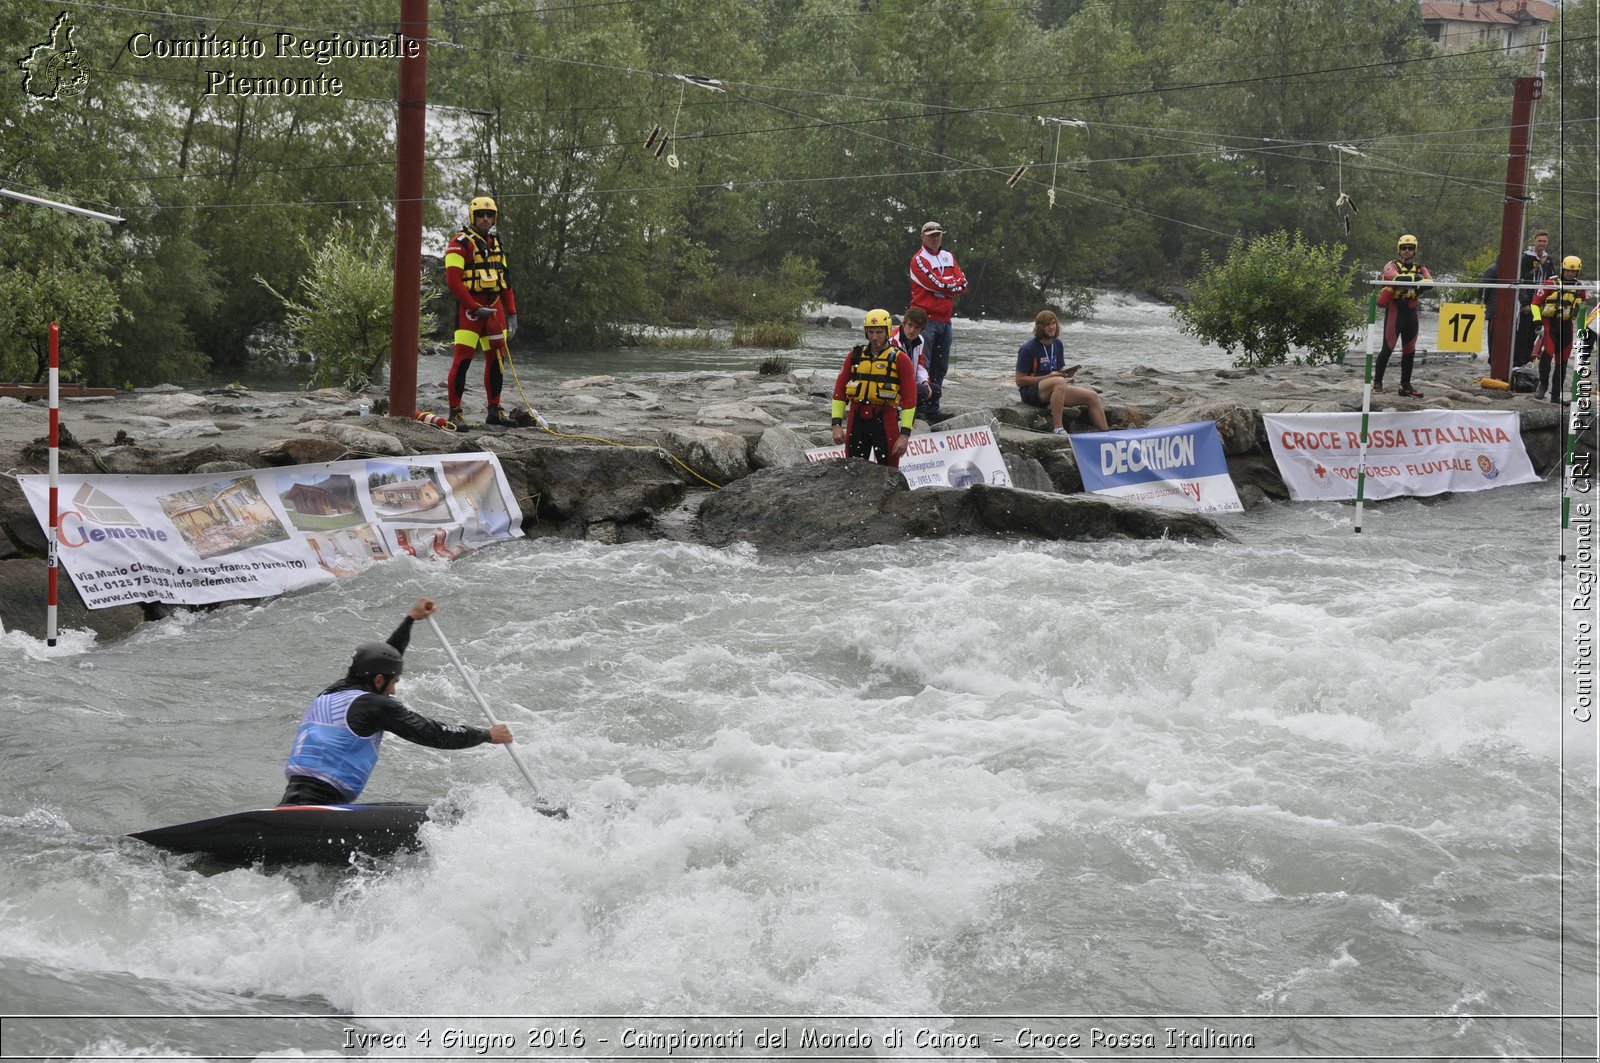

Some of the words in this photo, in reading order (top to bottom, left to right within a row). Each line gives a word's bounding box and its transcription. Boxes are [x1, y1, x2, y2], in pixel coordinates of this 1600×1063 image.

[1449, 313, 1476, 342] 17
[946, 430, 992, 451] RICAMBI
[1281, 431, 1342, 450] CROCE
[1345, 429, 1408, 449] ROSSA
[1412, 426, 1511, 447] ITALIANA
[1100, 434, 1195, 476] DECATHLON
[1332, 465, 1401, 480] SOCORSO
[1406, 458, 1473, 477] FLUVIALE
[917, 475, 932, 486] IVREA
[57, 510, 168, 548] Clemente
[75, 571, 95, 582] Via
[95, 567, 128, 580] Mario
[177, 565, 185, 575] 6
[193, 562, 251, 576] Borgofranco
[82, 583, 104, 594] Tel.
[104, 578, 133, 590] 0125
[173, 573, 259, 589] info@clemente.it
